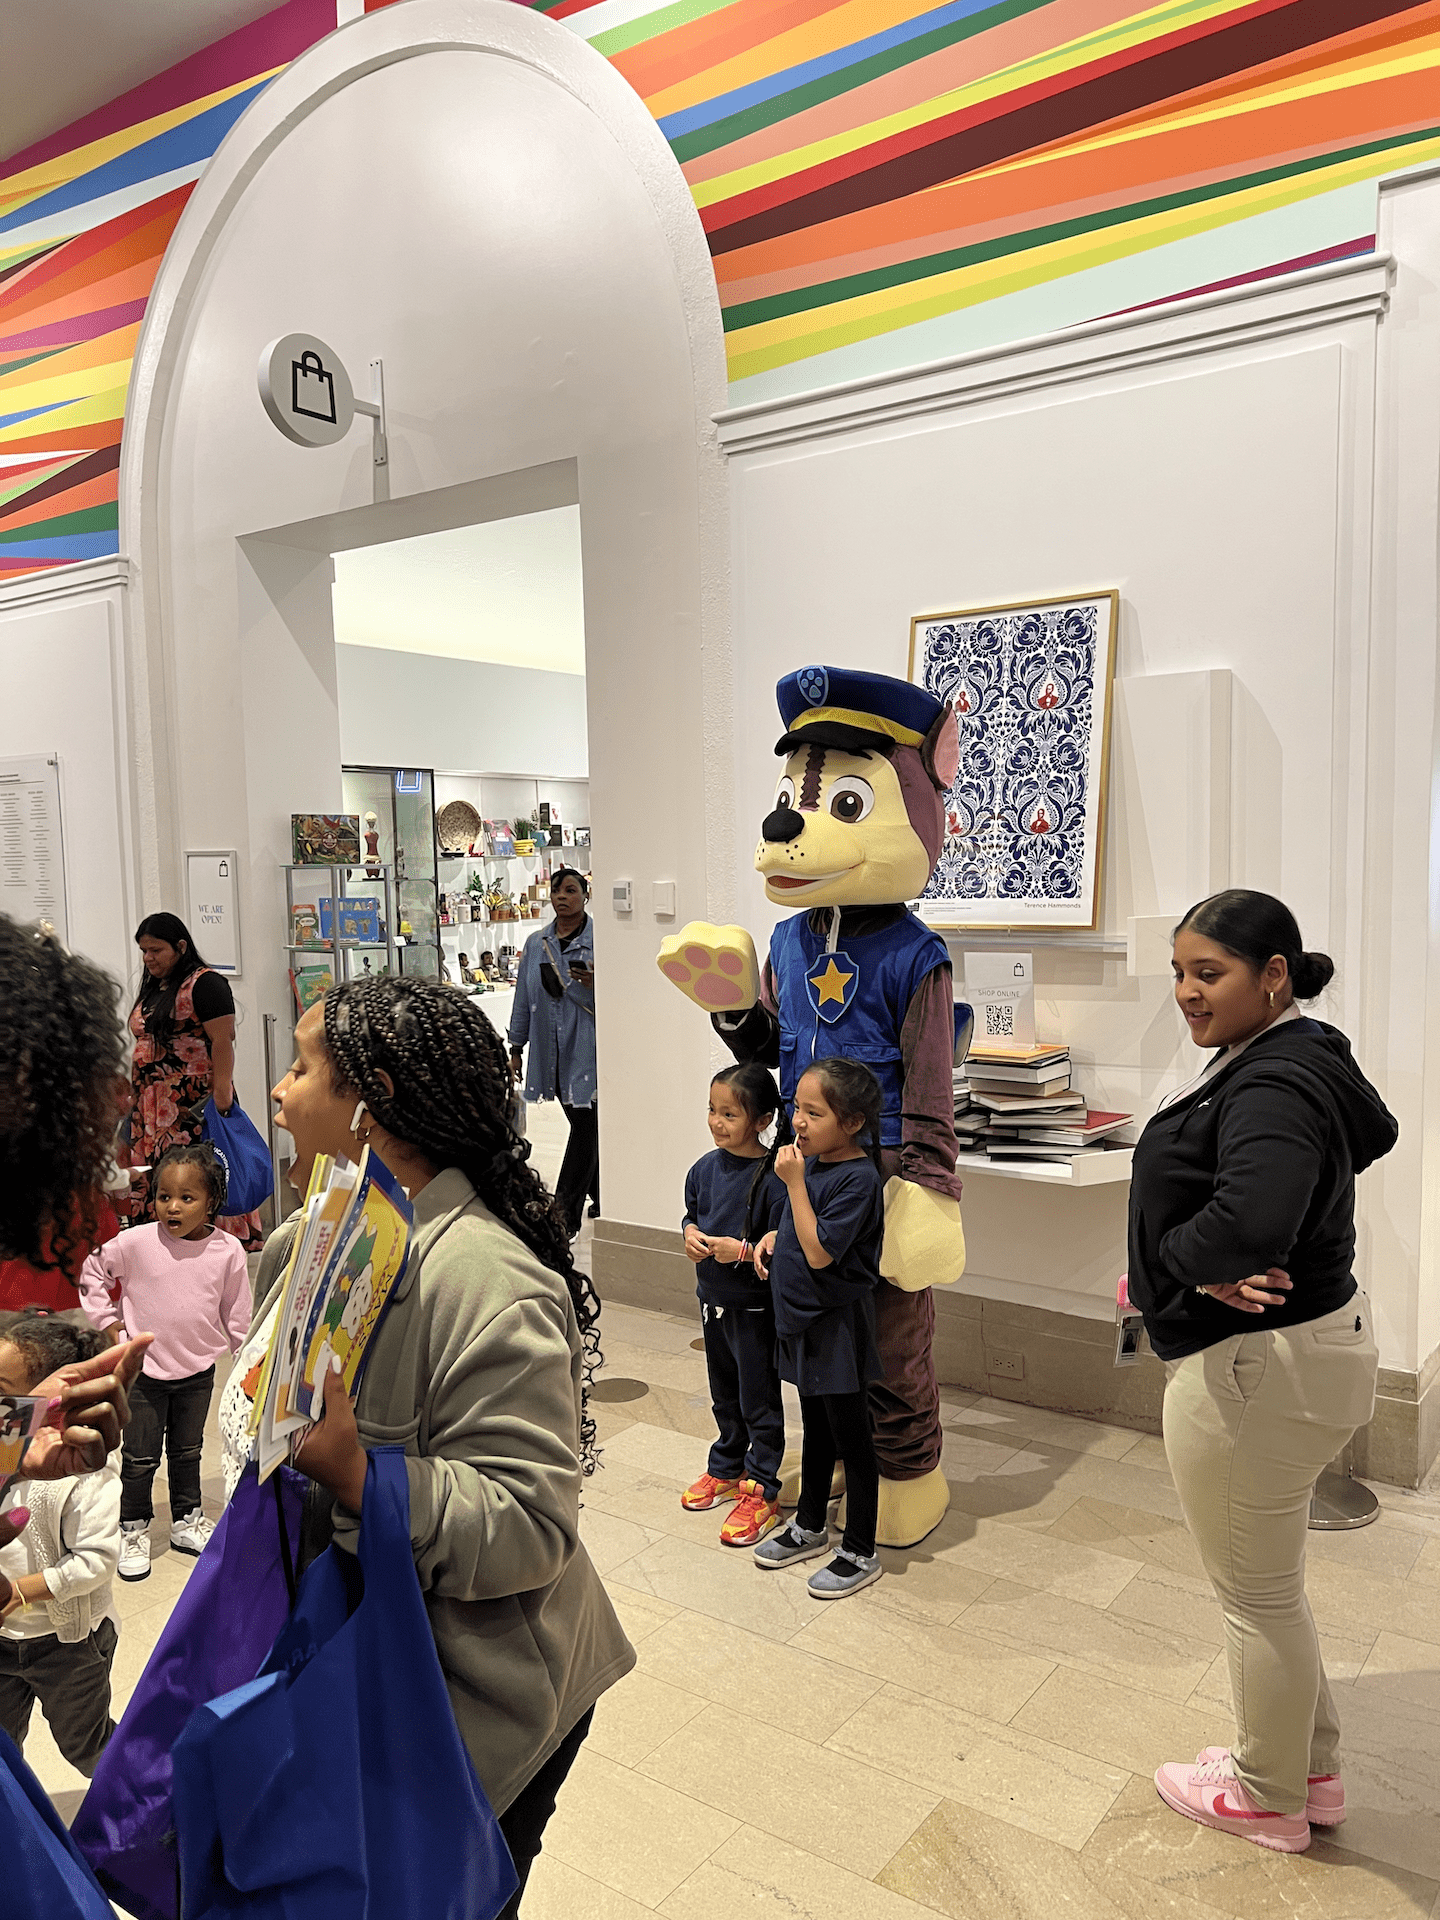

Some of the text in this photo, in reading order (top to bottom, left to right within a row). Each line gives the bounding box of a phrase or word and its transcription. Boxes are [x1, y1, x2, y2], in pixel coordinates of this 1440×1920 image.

[198, 905, 225, 914] WE ARE
[324, 901, 374, 911] AIMALS
[201, 915, 222, 924] OPEN!
[296, 1224, 327, 1320] TOGETHER
[294, 1285, 303, 1310] ALL
